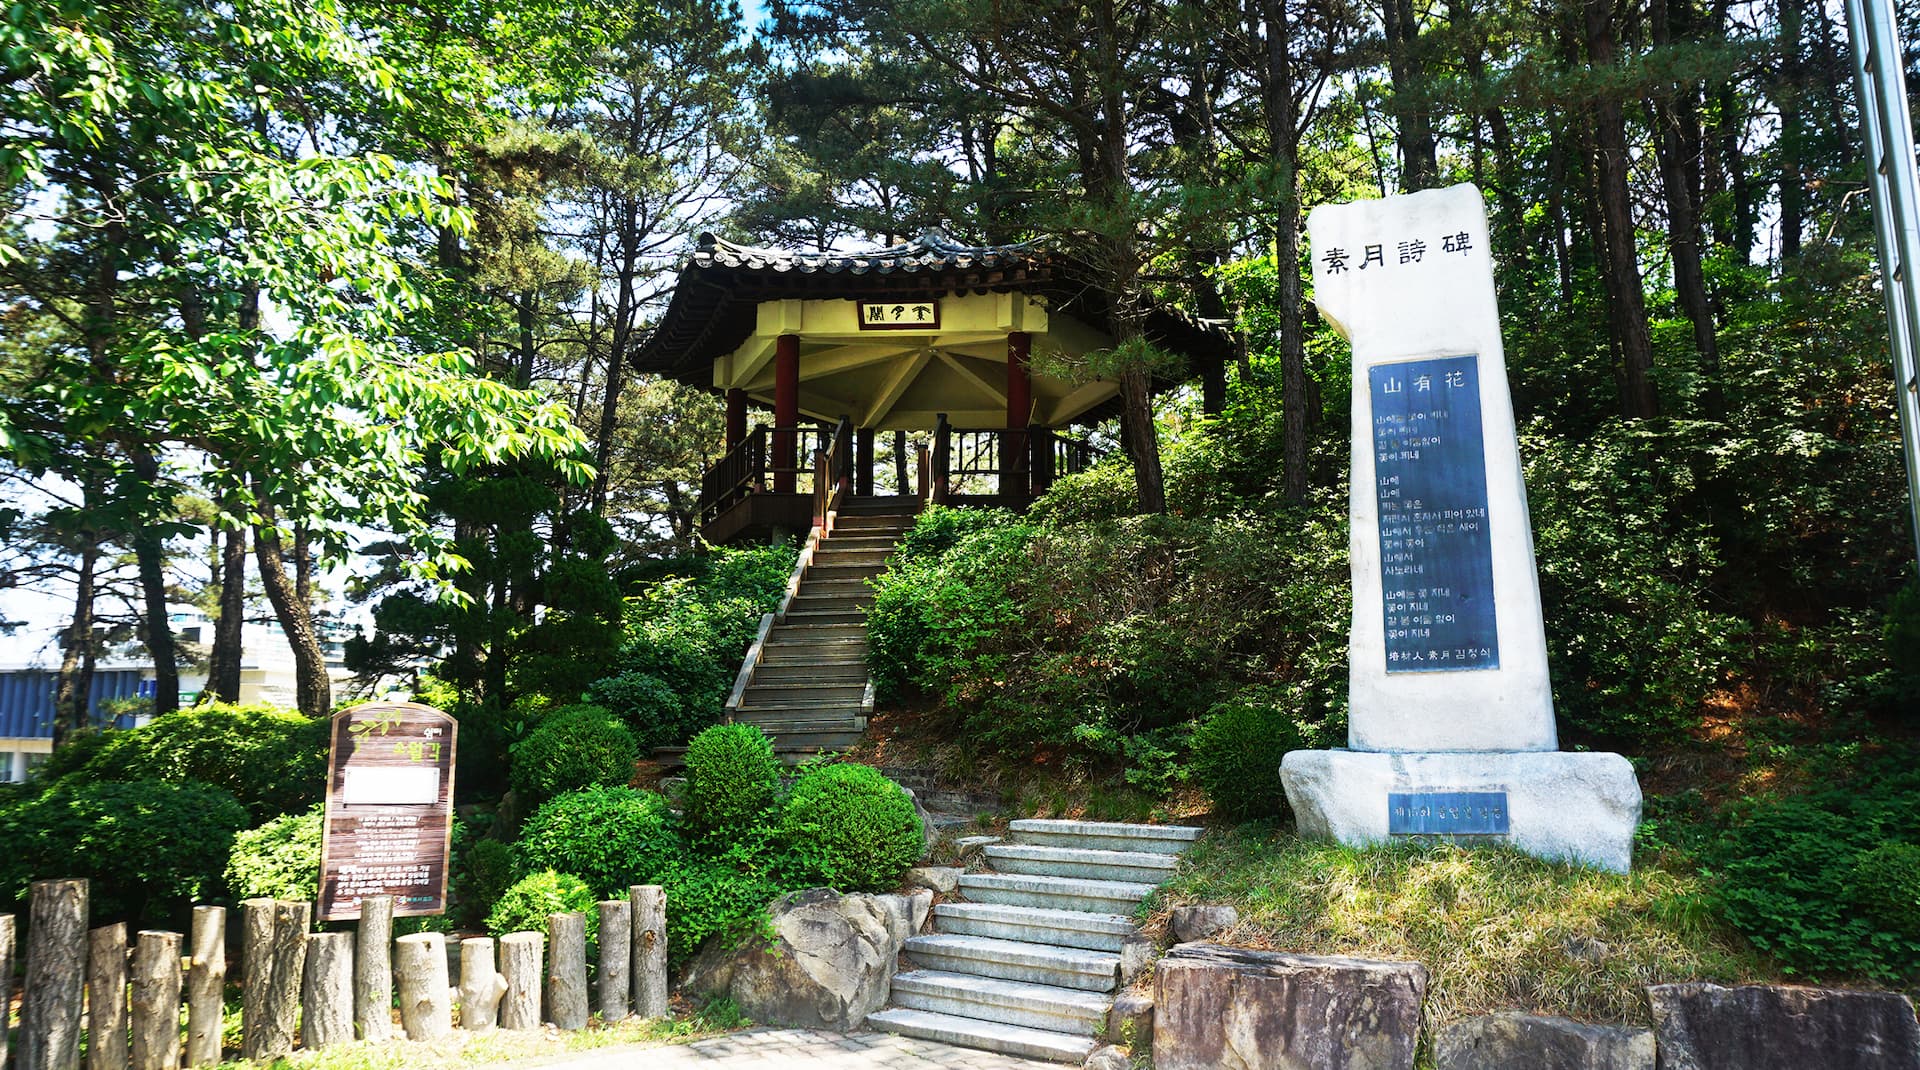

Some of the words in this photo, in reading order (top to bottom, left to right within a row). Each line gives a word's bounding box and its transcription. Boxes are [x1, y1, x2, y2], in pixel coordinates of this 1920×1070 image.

[1321, 231, 1473, 275] 素月詩碑
[1383, 370, 1465, 394] 山有花
[1380, 475, 1399, 486] 山에
[1380, 488, 1400, 499] 山에
[1444, 509, 1464, 520] 피어
[1466, 508, 1485, 519] 있네
[1383, 526, 1411, 537] 山에서
[1384, 553, 1413, 563] 山에서
[1385, 564, 1424, 576] 사노라네
[1386, 590, 1415, 601] 山에는
[1431, 587, 1450, 598] 지네
[1387, 602, 1406, 613] 꽃이
[1409, 601, 1429, 612] 지네
[1388, 628, 1408, 640] 꽃이
[1411, 627, 1431, 639] 지네
[1427, 649, 1450, 661] 素月
[1455, 647, 1491, 660] 김정식
[393, 741, 441, 763] 소월각
